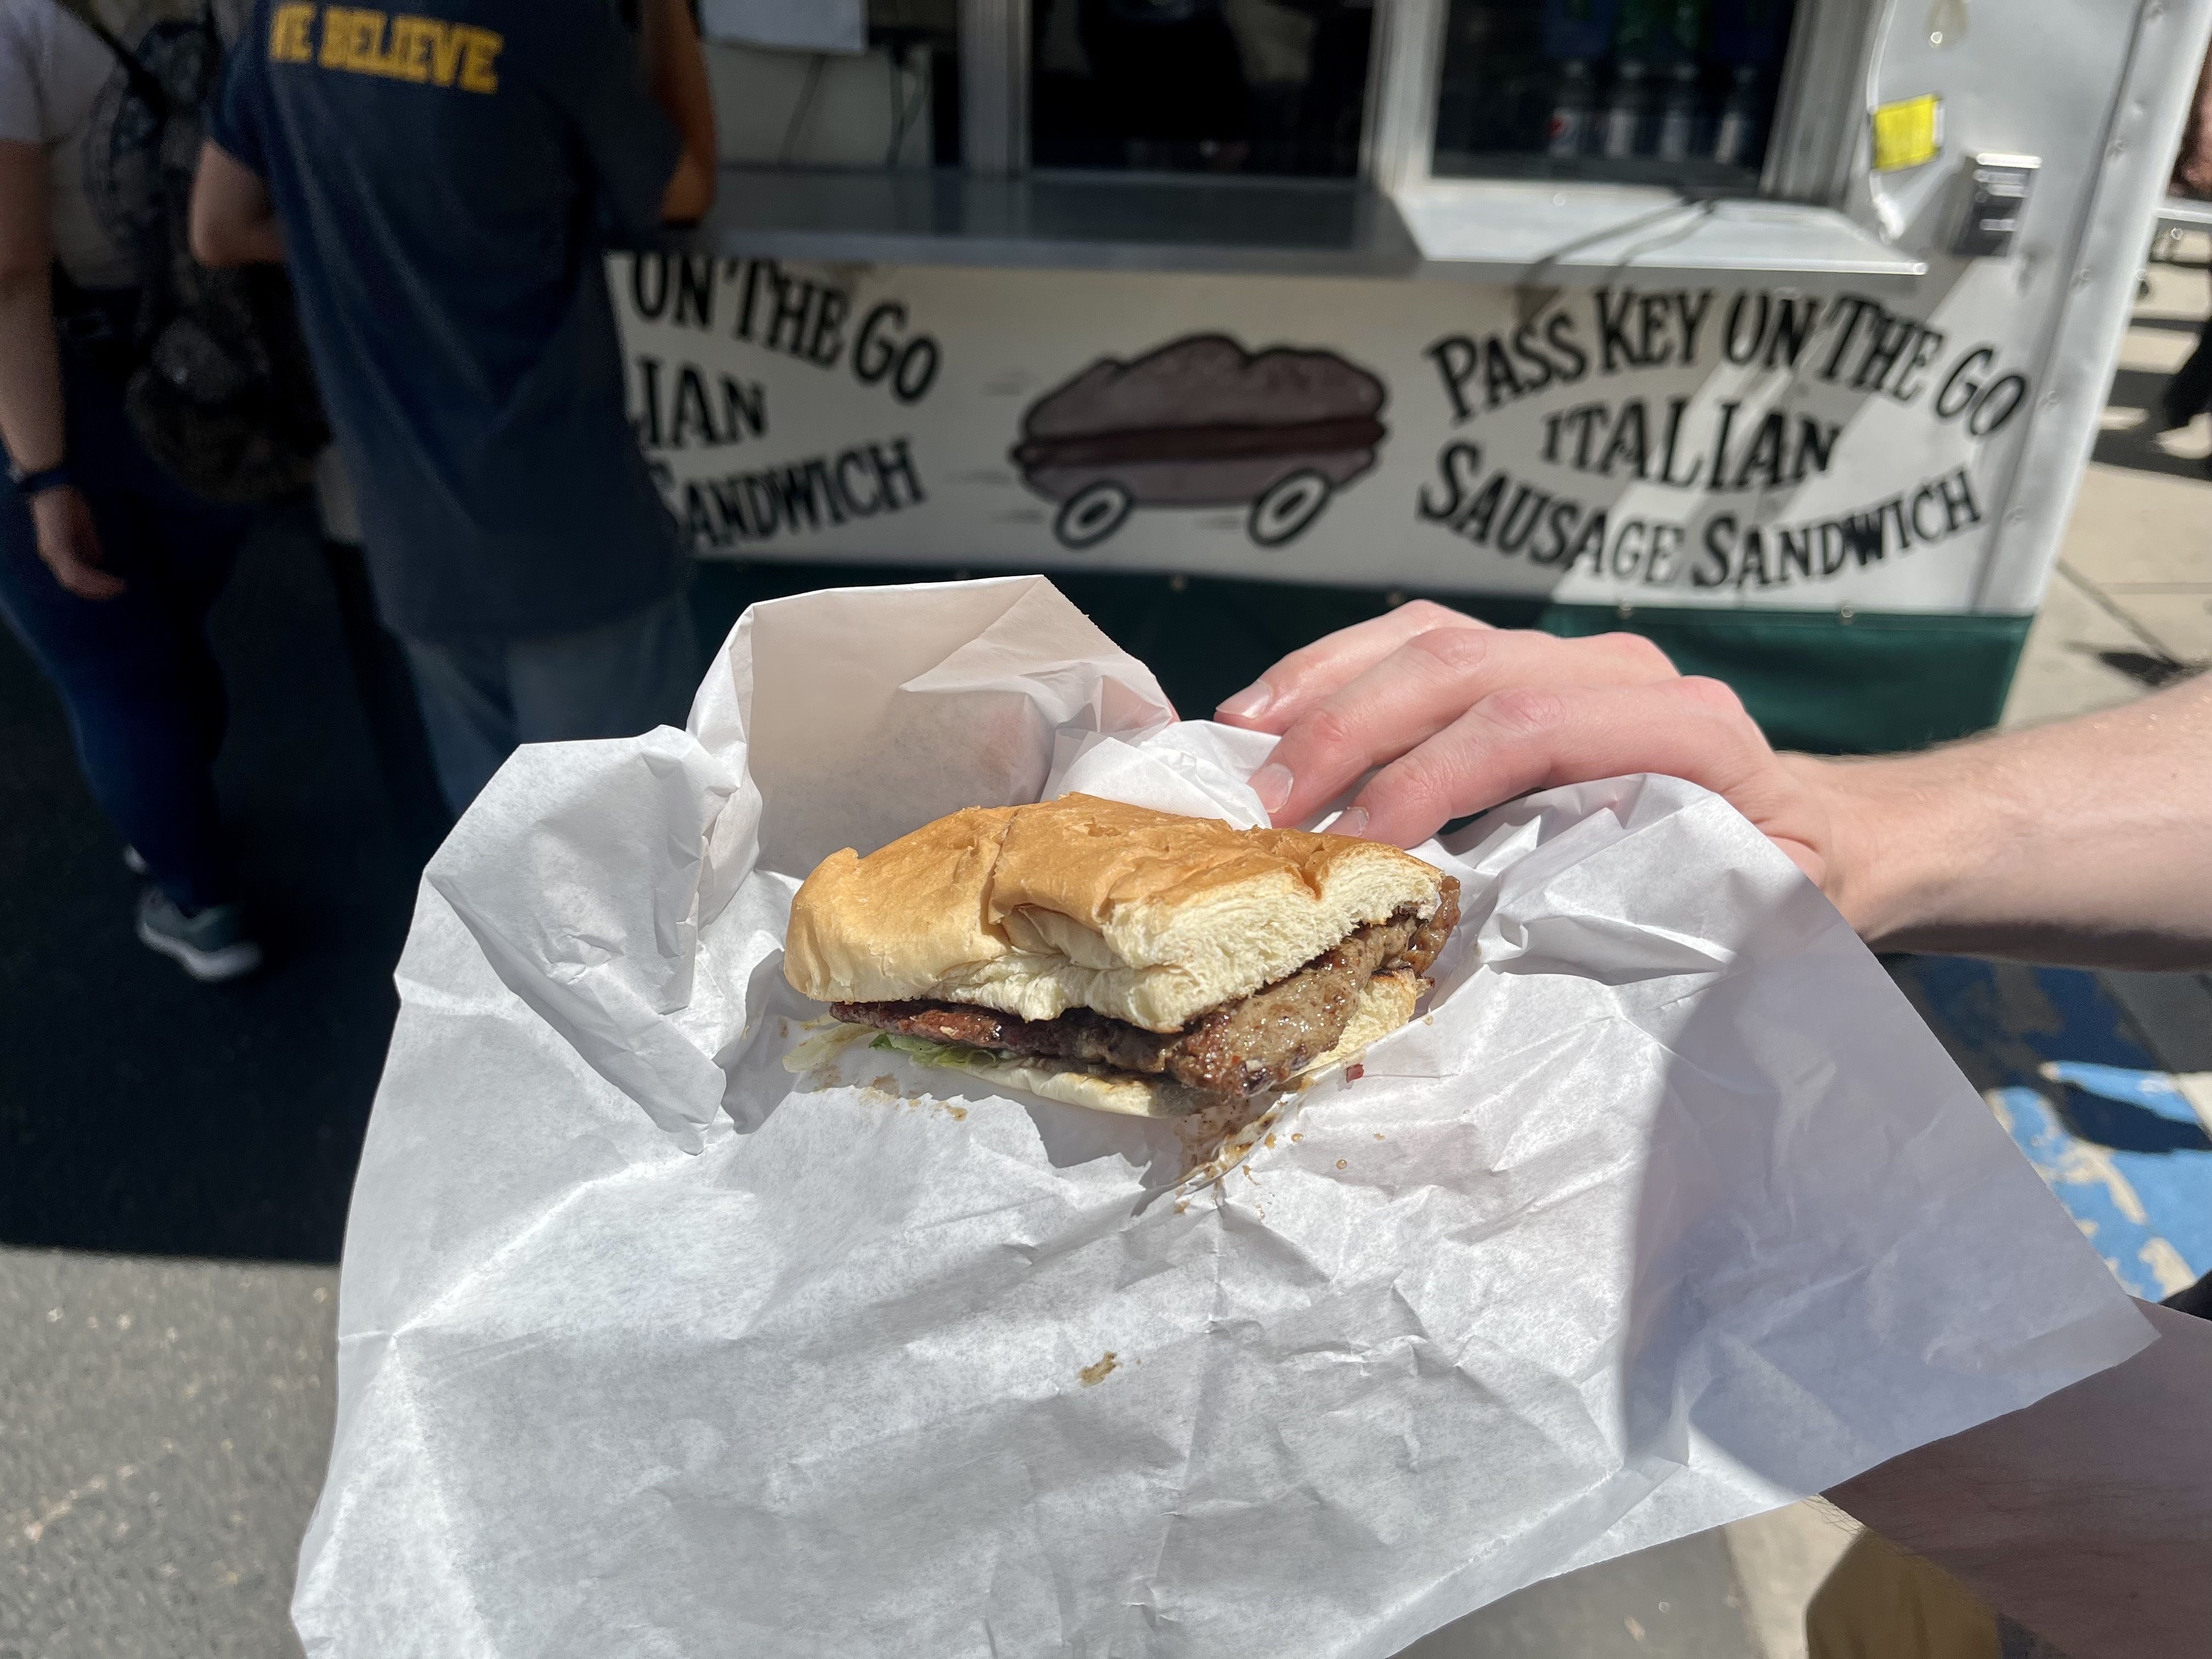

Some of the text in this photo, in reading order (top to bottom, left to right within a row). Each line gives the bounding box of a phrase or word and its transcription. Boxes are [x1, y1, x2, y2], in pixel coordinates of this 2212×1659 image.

[271, 3, 504, 94] E BELIEVE
[722, 257, 848, 369] THE
[851, 300, 941, 405] GO
[1424, 312, 1587, 421] PASS
[1595, 287, 1713, 373] KEY
[1820, 292, 1944, 400] THE
[1937, 347, 2027, 437] GO
[635, 357, 766, 447] IAN
[1543, 396, 1842, 490] ITALIAN
[1417, 441, 1981, 588] SAUSAGE SANDWICH
